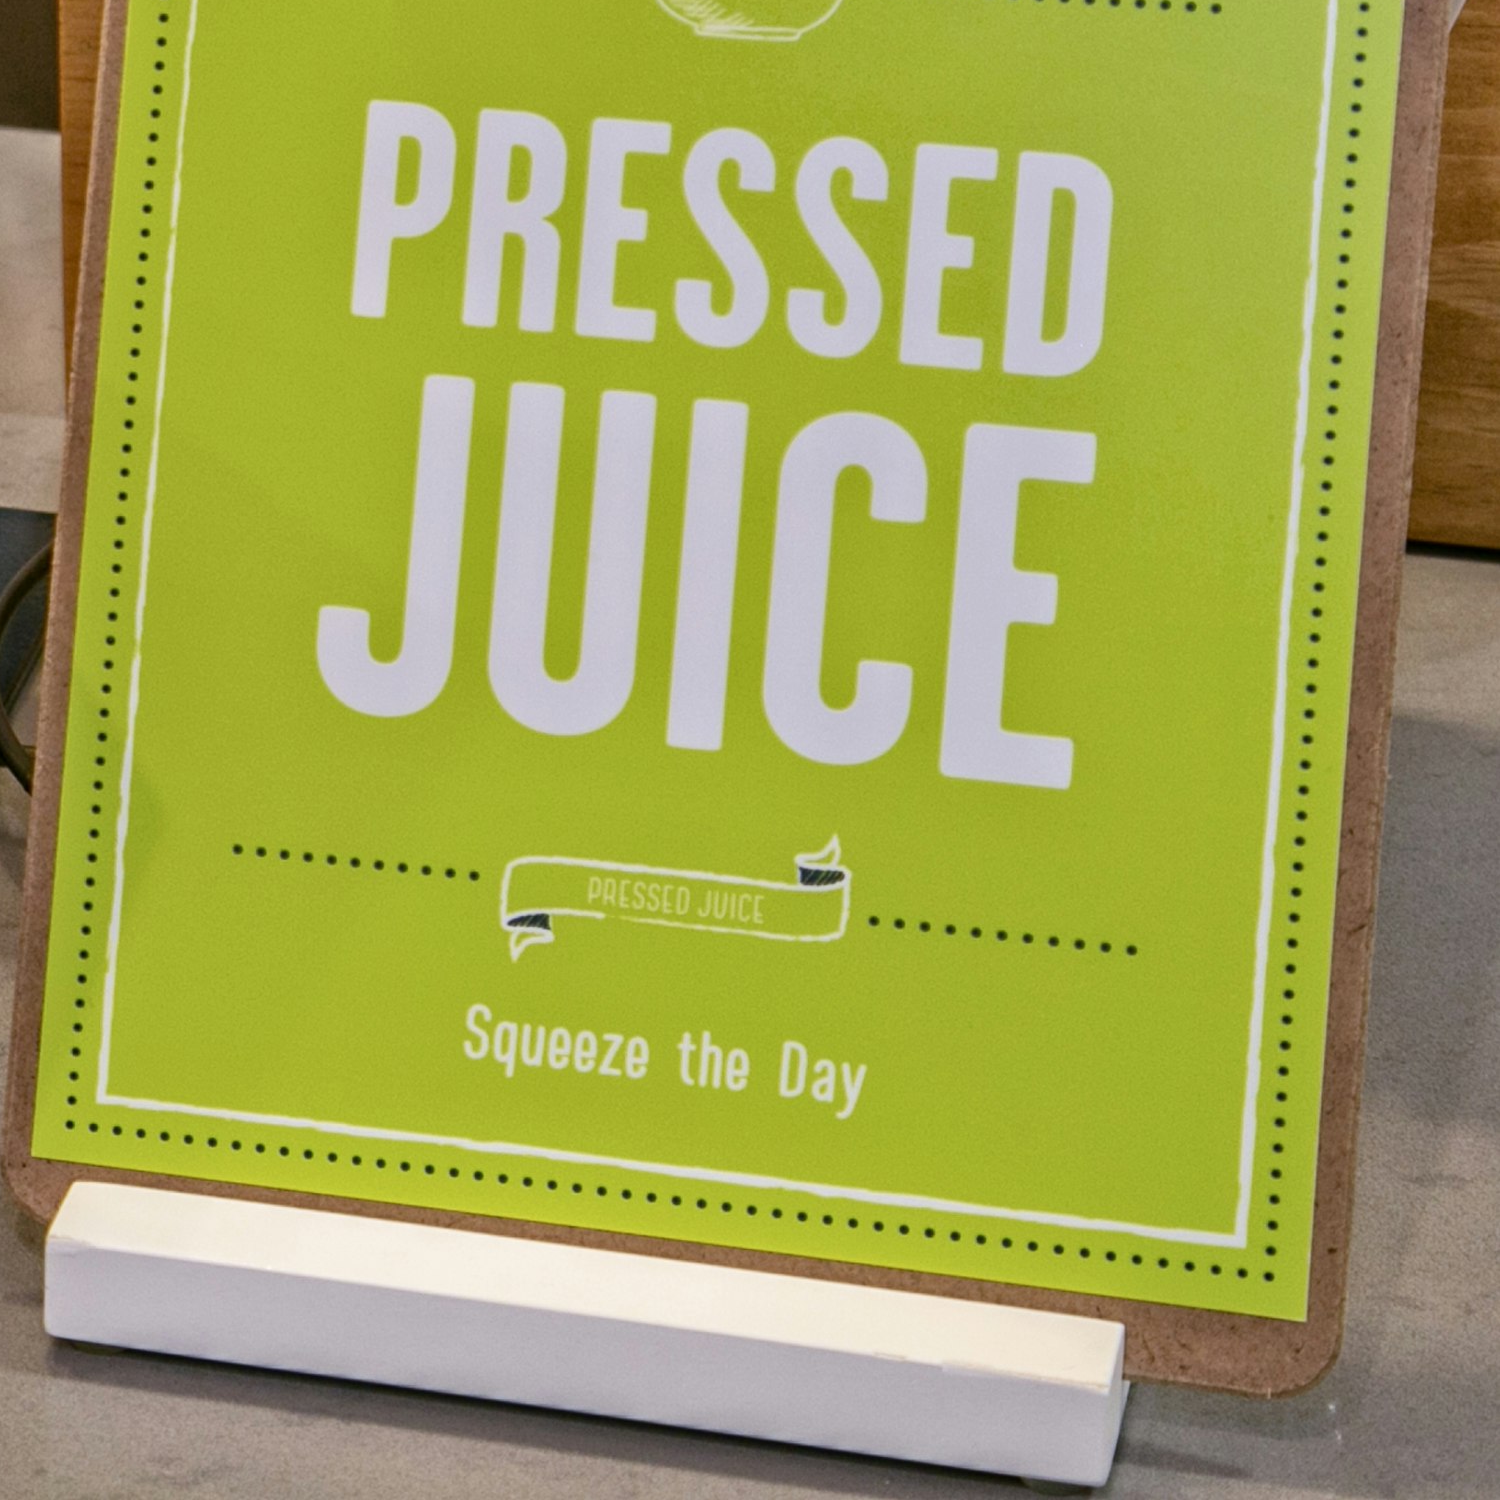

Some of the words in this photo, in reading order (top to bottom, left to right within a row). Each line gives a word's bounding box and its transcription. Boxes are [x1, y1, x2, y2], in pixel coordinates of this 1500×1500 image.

[350, 98, 1116, 379] PRESSED
[314, 372, 1099, 791] JUICE
[587, 876, 691, 917] PRESSED
[697, 889, 766, 925] JUICE
[463, 1003, 650, 1080] Squeeze
[677, 1030, 750, 1092] the
[778, 1040, 868, 1120] Day
